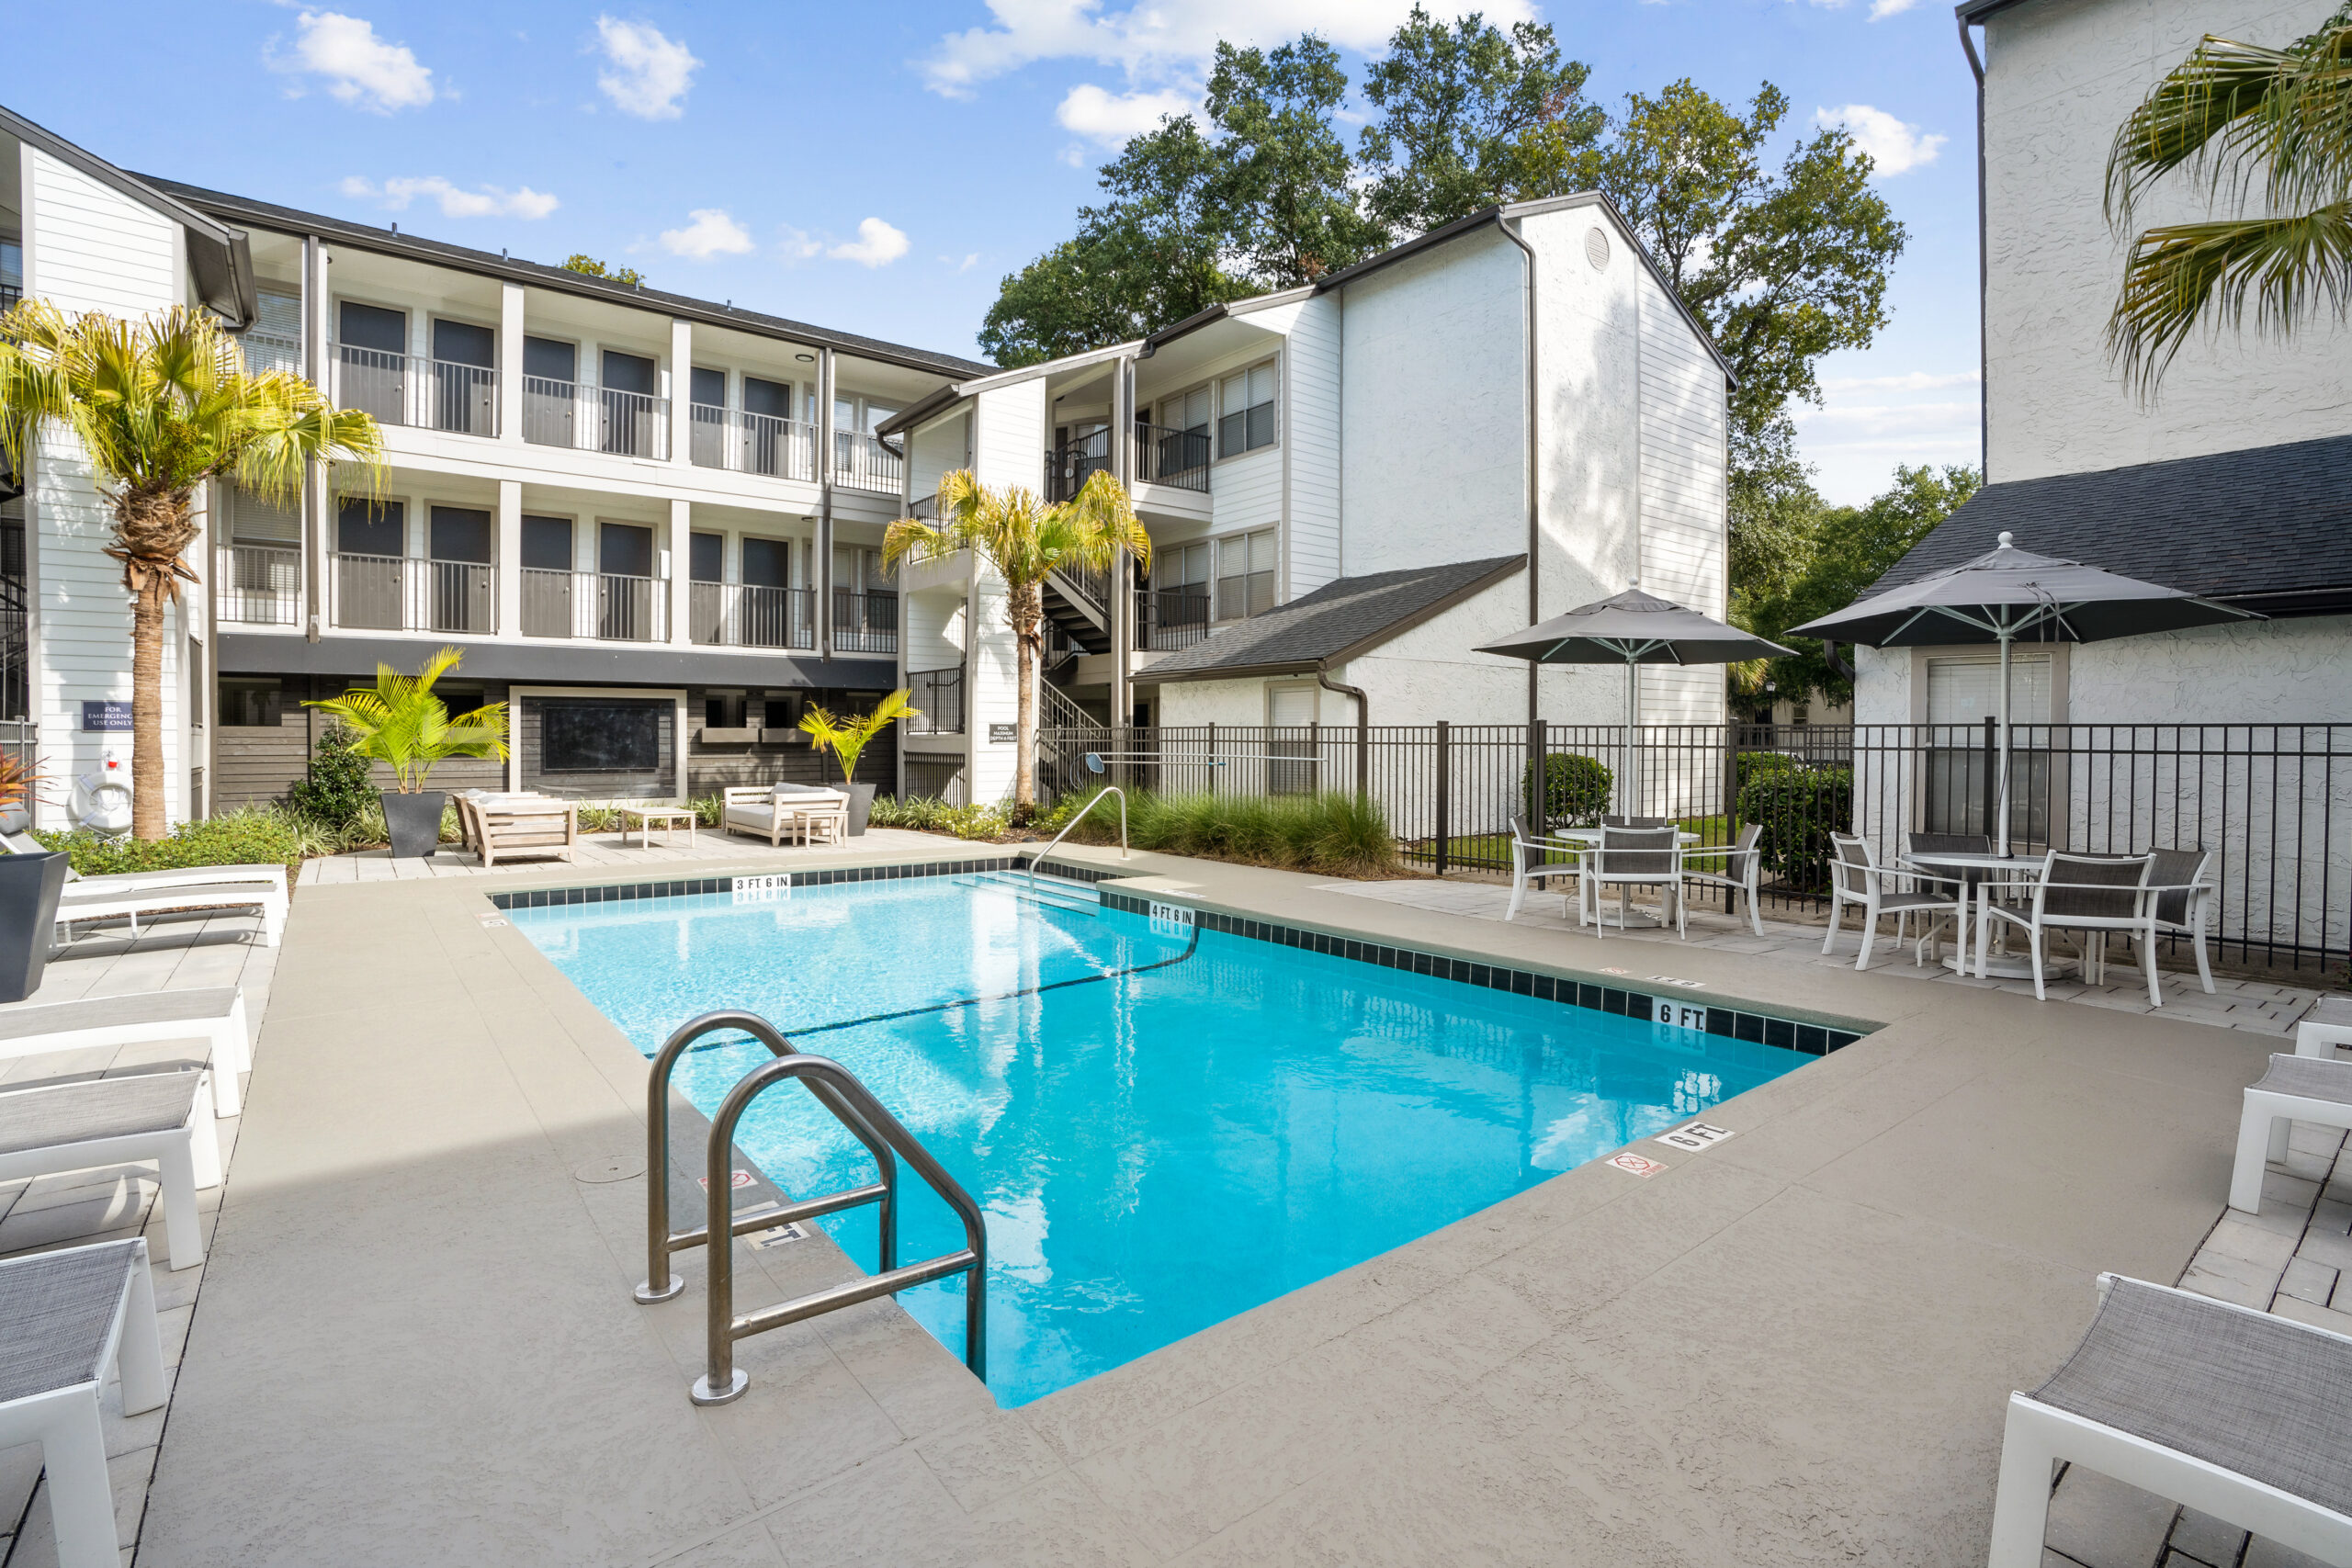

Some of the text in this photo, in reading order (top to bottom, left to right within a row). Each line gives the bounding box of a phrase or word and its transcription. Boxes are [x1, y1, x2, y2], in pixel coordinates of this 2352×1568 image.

[737, 879, 743, 890] 3
[765, 877, 773, 887] 6
[1152, 905, 1158, 917] 4
[1174, 909, 1180, 921] 6
[1660, 1004, 1703, 1031] 6 FT.
[1668, 1123, 1729, 1147] 6 FT.
